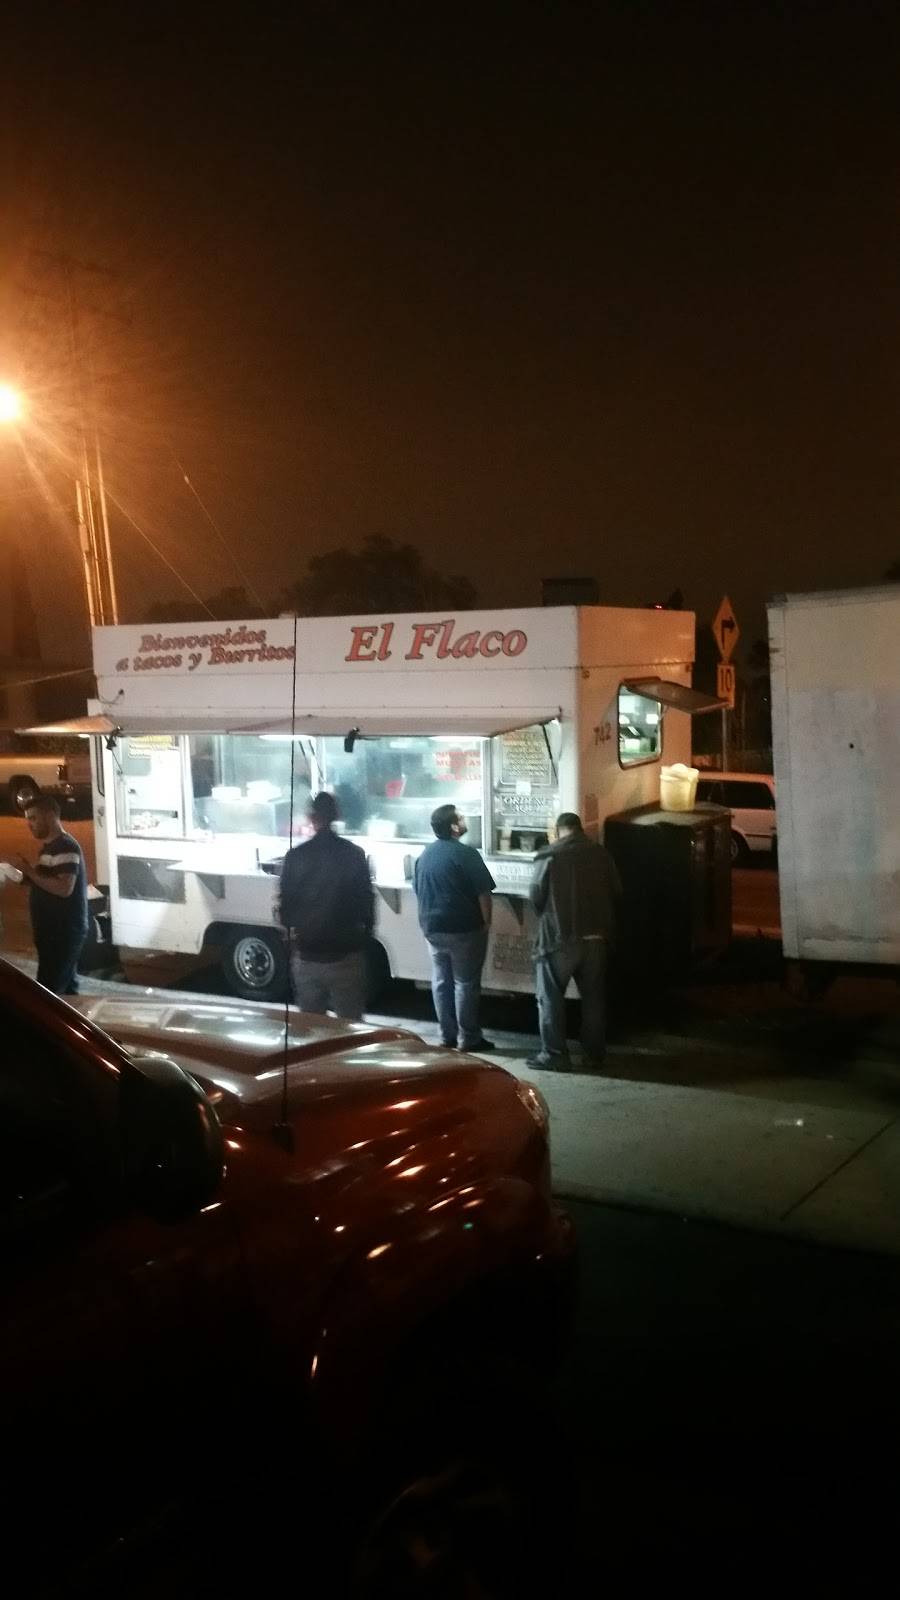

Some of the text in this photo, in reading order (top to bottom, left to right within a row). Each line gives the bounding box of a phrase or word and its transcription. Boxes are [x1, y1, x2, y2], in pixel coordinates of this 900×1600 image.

[138, 625, 267, 653] Bienvenidos
[345, 619, 528, 662] El Flaco
[115, 643, 296, 672] a tacos y Burritos
[719, 667, 733, 693] 10
[592, 722, 613, 747] 742
